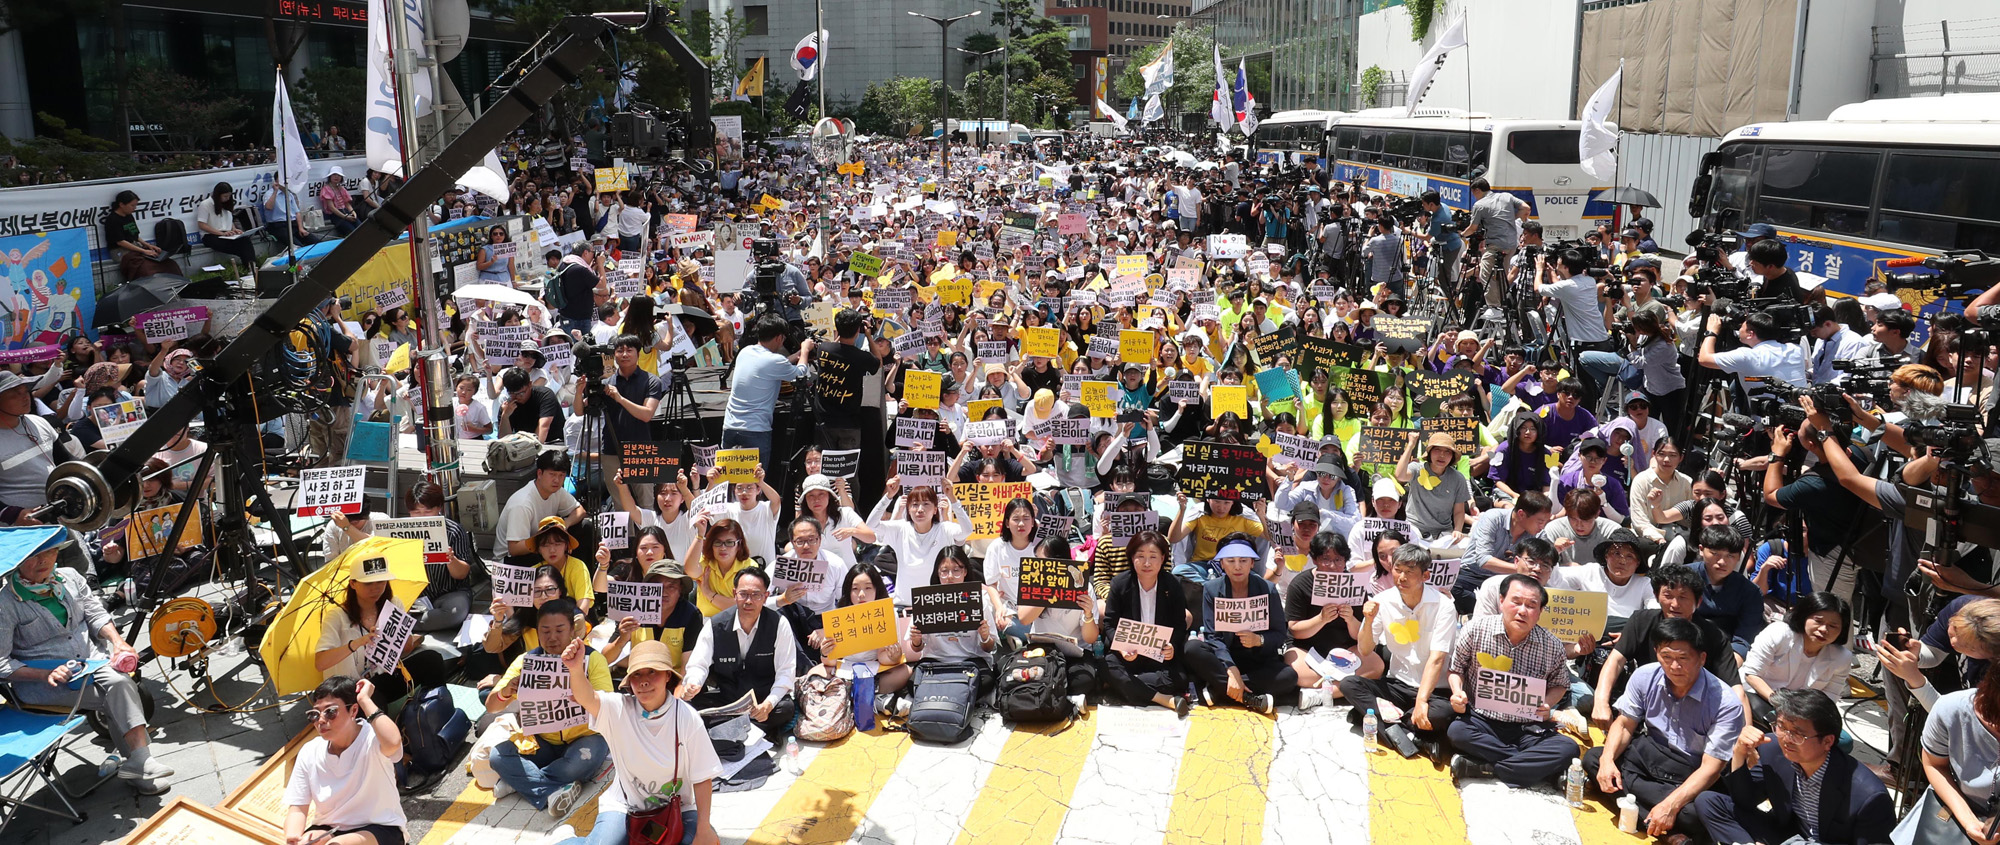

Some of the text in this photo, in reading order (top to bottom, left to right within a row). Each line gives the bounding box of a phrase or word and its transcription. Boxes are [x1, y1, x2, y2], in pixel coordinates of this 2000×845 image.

[333, 6, 349, 19] 파리
[1440, 186, 1462, 202] POLICE
[1545, 196, 1578, 205] POLICE
[690, 233, 706, 243] WAR
[144, 320, 175, 331] 우리가
[146, 326, 186, 338] 증인이다
[486, 348, 521, 358] 싸웁시다
[978, 350, 1006, 358] 싸웁시다
[1309, 344, 1333, 356] 사과가
[1170, 381, 1187, 389] 끝까지
[1423, 377, 1459, 389] 전범자를
[1170, 389, 1199, 398] 싸웁시다
[1424, 387, 1460, 398] 처벌하라
[897, 417, 936, 429] 끝까지 함께
[966, 422, 995, 430] 우리가
[1051, 418, 1080, 429] 우리가
[1422, 418, 1465, 430] 일본정부는
[896, 428, 935, 441] 싸웁시다
[966, 428, 1006, 438] 증인이다
[1051, 428, 1090, 439] 증인이다
[1363, 428, 1395, 439] 저희가
[1277, 433, 1320, 450] 끝까지 함께
[1373, 440, 1402, 451] 위드유
[623, 443, 659, 456] 일본정부는
[898, 451, 944, 463] 끝까지 함께
[304, 467, 362, 481] 일본은 전쟁범죄
[623, 467, 649, 478] 들어라
[897, 463, 944, 477] 싸웁시다
[1186, 463, 1229, 475] 가려지지
[307, 480, 355, 493] 사죄하고
[955, 484, 990, 502] 진실은
[992, 483, 1031, 499] 아베정부
[306, 491, 357, 505] 배상하라!
[375, 520, 443, 531] 한일군사정보보호협정
[1041, 516, 1067, 529] 우리가
[1111, 513, 1147, 526] 우리가
[1364, 519, 1410, 533] 끝까지 함께
[390, 530, 431, 540] GSOMIA
[776, 557, 814, 571] 우리가
[514, 568, 535, 582] 함께
[774, 568, 824, 584] 증인이다
[1021, 574, 1069, 588] 역사 앞에
[1314, 572, 1355, 586] 우리가
[608, 582, 662, 598] 끝까지 함께
[1314, 584, 1366, 599] 증인이다
[608, 595, 661, 613] 싸웁시다
[913, 592, 957, 607] 기억하라
[1215, 595, 1268, 610] 끝까지 함께
[1552, 594, 1575, 604] 당신을
[1215, 609, 1269, 624] 싸웁시다
[1552, 606, 1591, 616] 하겠습니다
[914, 611, 959, 626] 사죄하라
[1551, 617, 1574, 626] 당신과
[1118, 619, 1159, 636] 우리가
[1551, 628, 1589, 636] 하겠습니다
[371, 607, 403, 665] 싸웁시다
[1115, 630, 1167, 650] 증인이다
[383, 615, 413, 673] 끝까지 함께
[523, 657, 558, 673] 끝까지
[520, 673, 570, 690] 싸웁시
[1478, 669, 1529, 693] 우리가
[1477, 683, 1544, 708] 증인이다
[520, 699, 570, 714] 우리가
[522, 706, 587, 728] 증인이다
